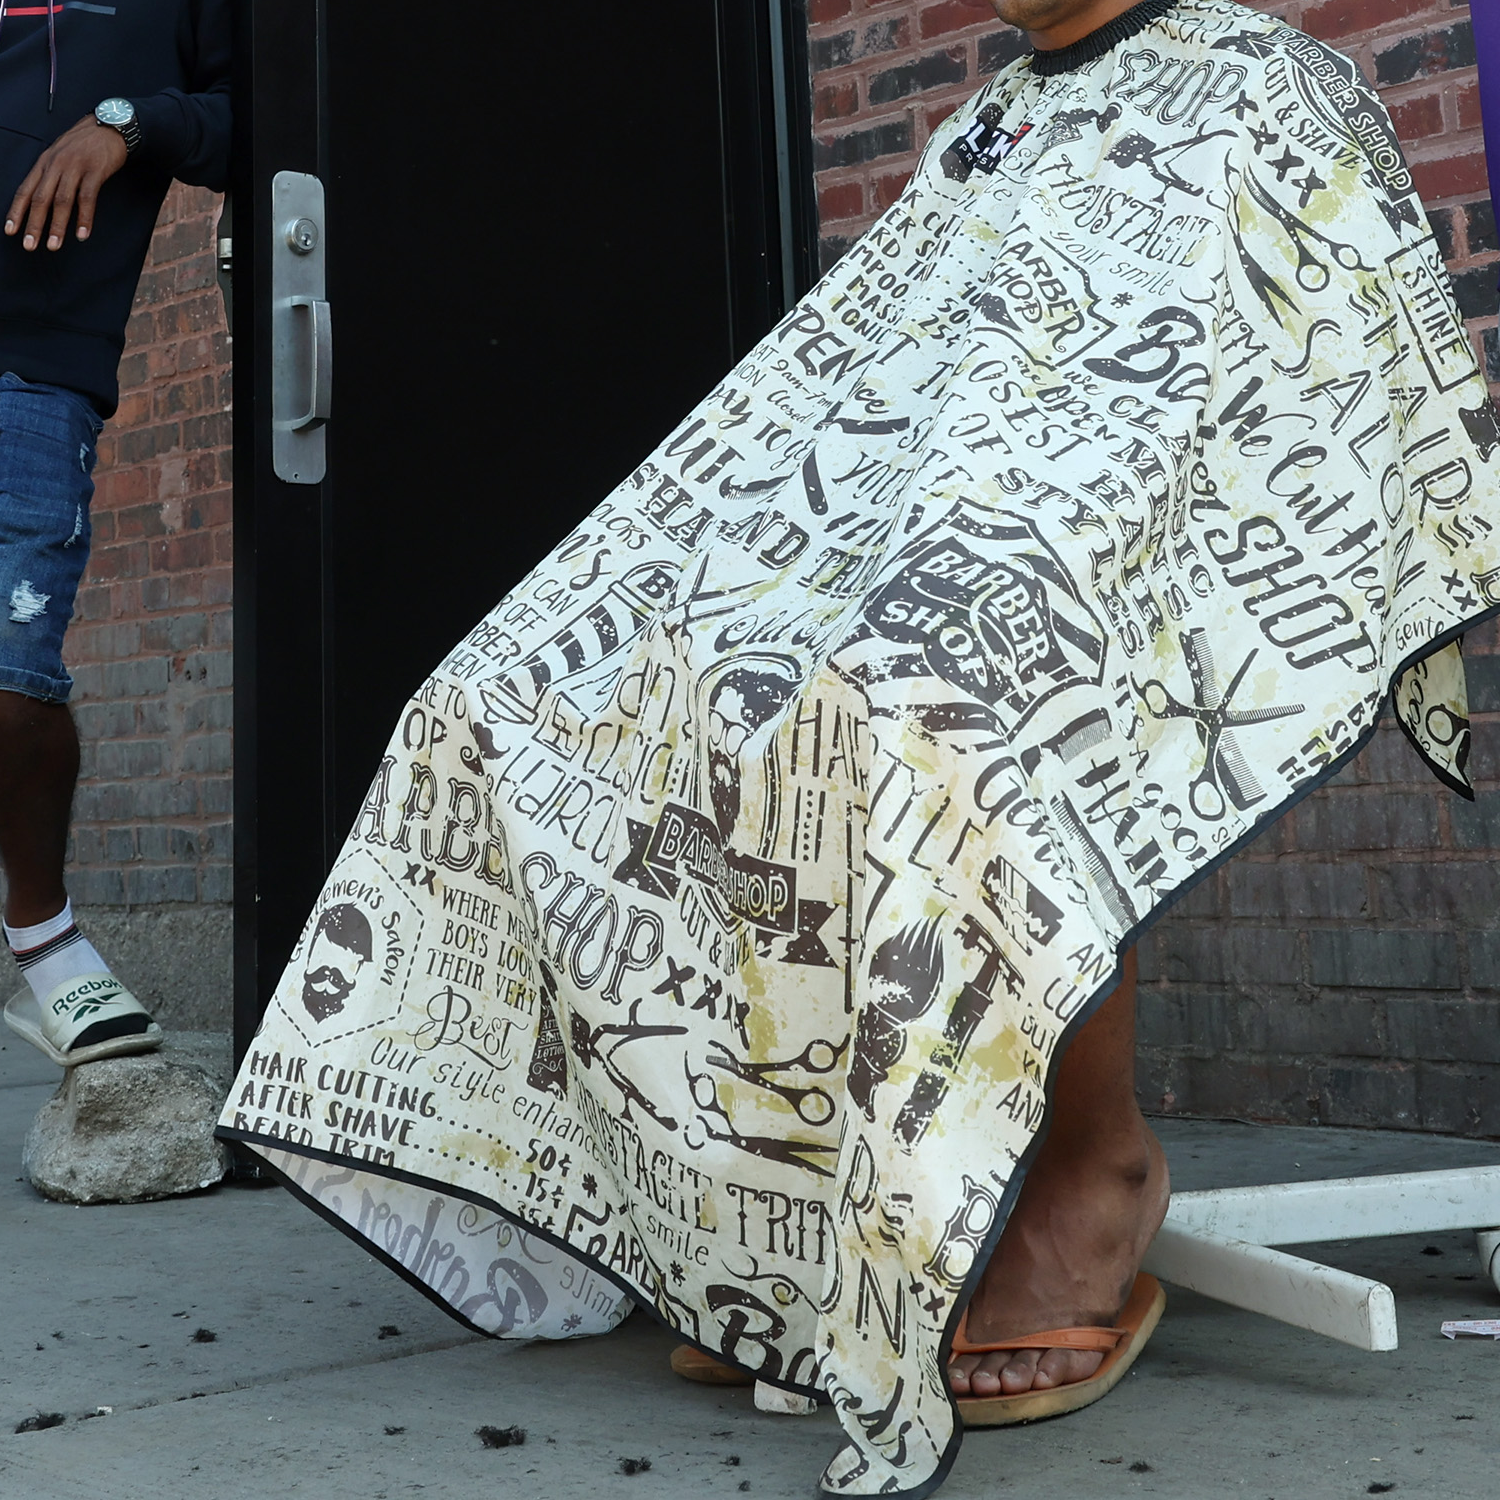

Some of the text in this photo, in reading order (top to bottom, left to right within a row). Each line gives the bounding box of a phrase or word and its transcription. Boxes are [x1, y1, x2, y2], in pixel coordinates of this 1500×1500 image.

[1270, 27, 1414, 195] BARBER SHOP
[1275, 101, 1300, 125] &
[1287, 118, 1367, 169] SHAVE
[1110, 259, 1175, 296] smile
[1402, 265, 1465, 366] SHINE
[915, 548, 1051, 671] BARBER
[1203, 515, 1379, 674] SHOP
[879, 599, 990, 690] SHOP
[442, 884, 500, 930] WHERE
[441, 919, 536, 982] BOYS LOOK
[52, 978, 123, 1016] Reebok
[425, 947, 538, 1017] THEIR VERY
[406, 984, 530, 1071] Best
[249, 1050, 309, 1085] HAIR
[370, 1036, 427, 1074] Our
[237, 1080, 314, 1120] AFTER
[645, 1214, 710, 1267] smile
